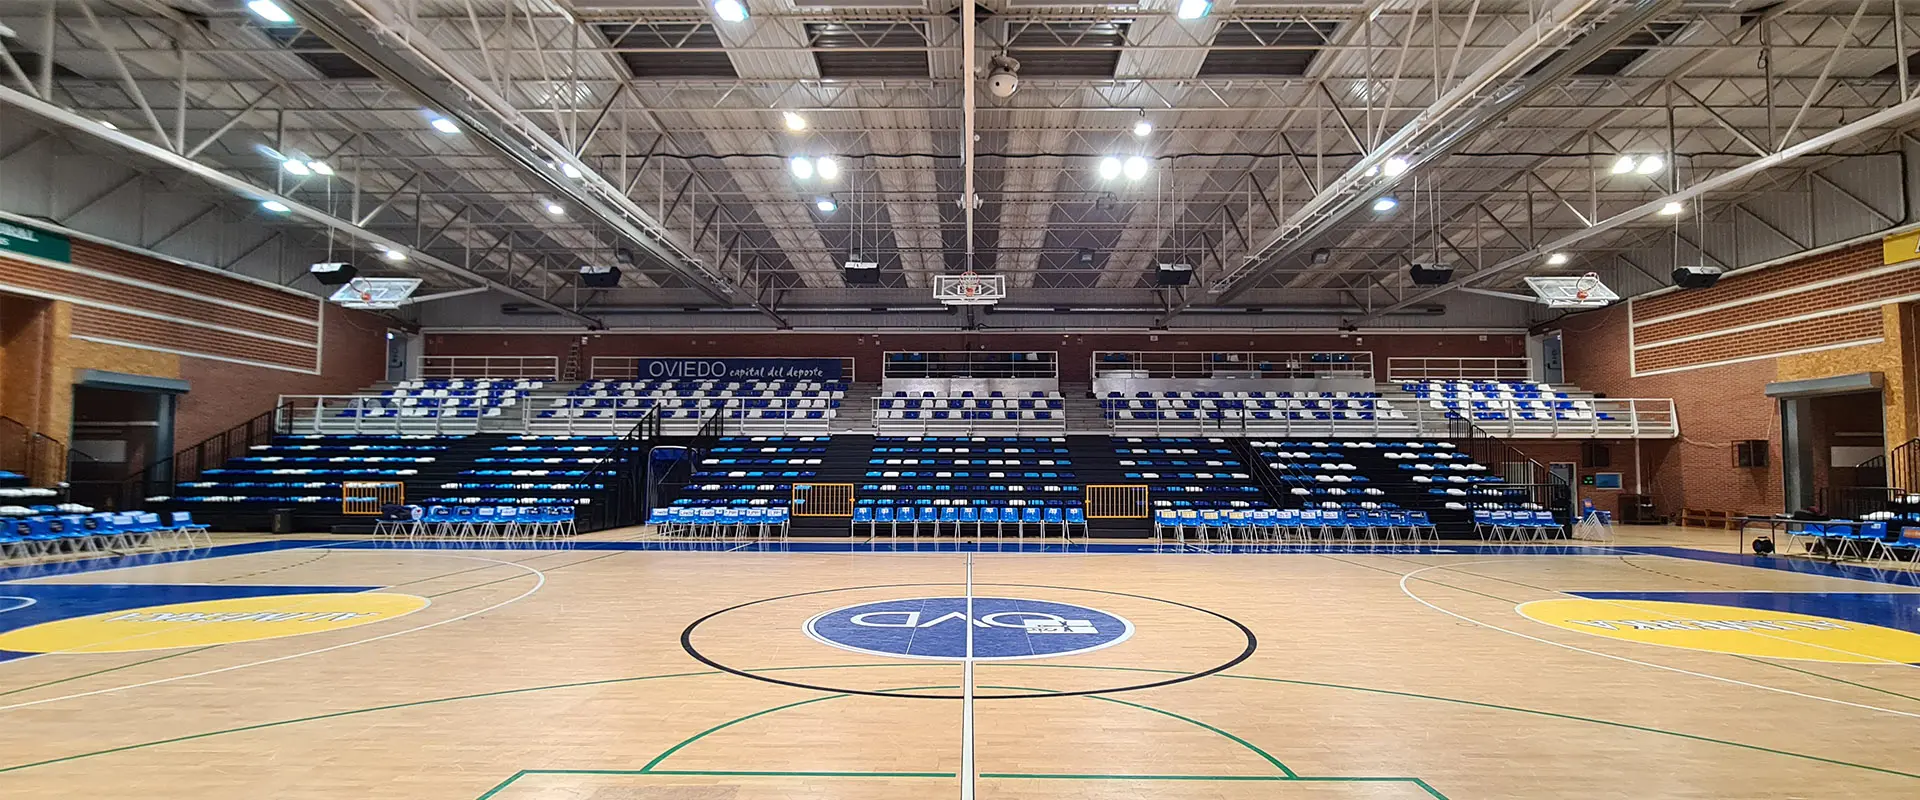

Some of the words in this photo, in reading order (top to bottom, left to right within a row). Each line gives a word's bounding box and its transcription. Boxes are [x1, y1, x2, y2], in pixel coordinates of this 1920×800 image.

[649, 361, 726, 377] OVIEDO
[729, 367, 764, 378] capital
[768, 366, 783, 377] del
[786, 366, 823, 378] deporte
